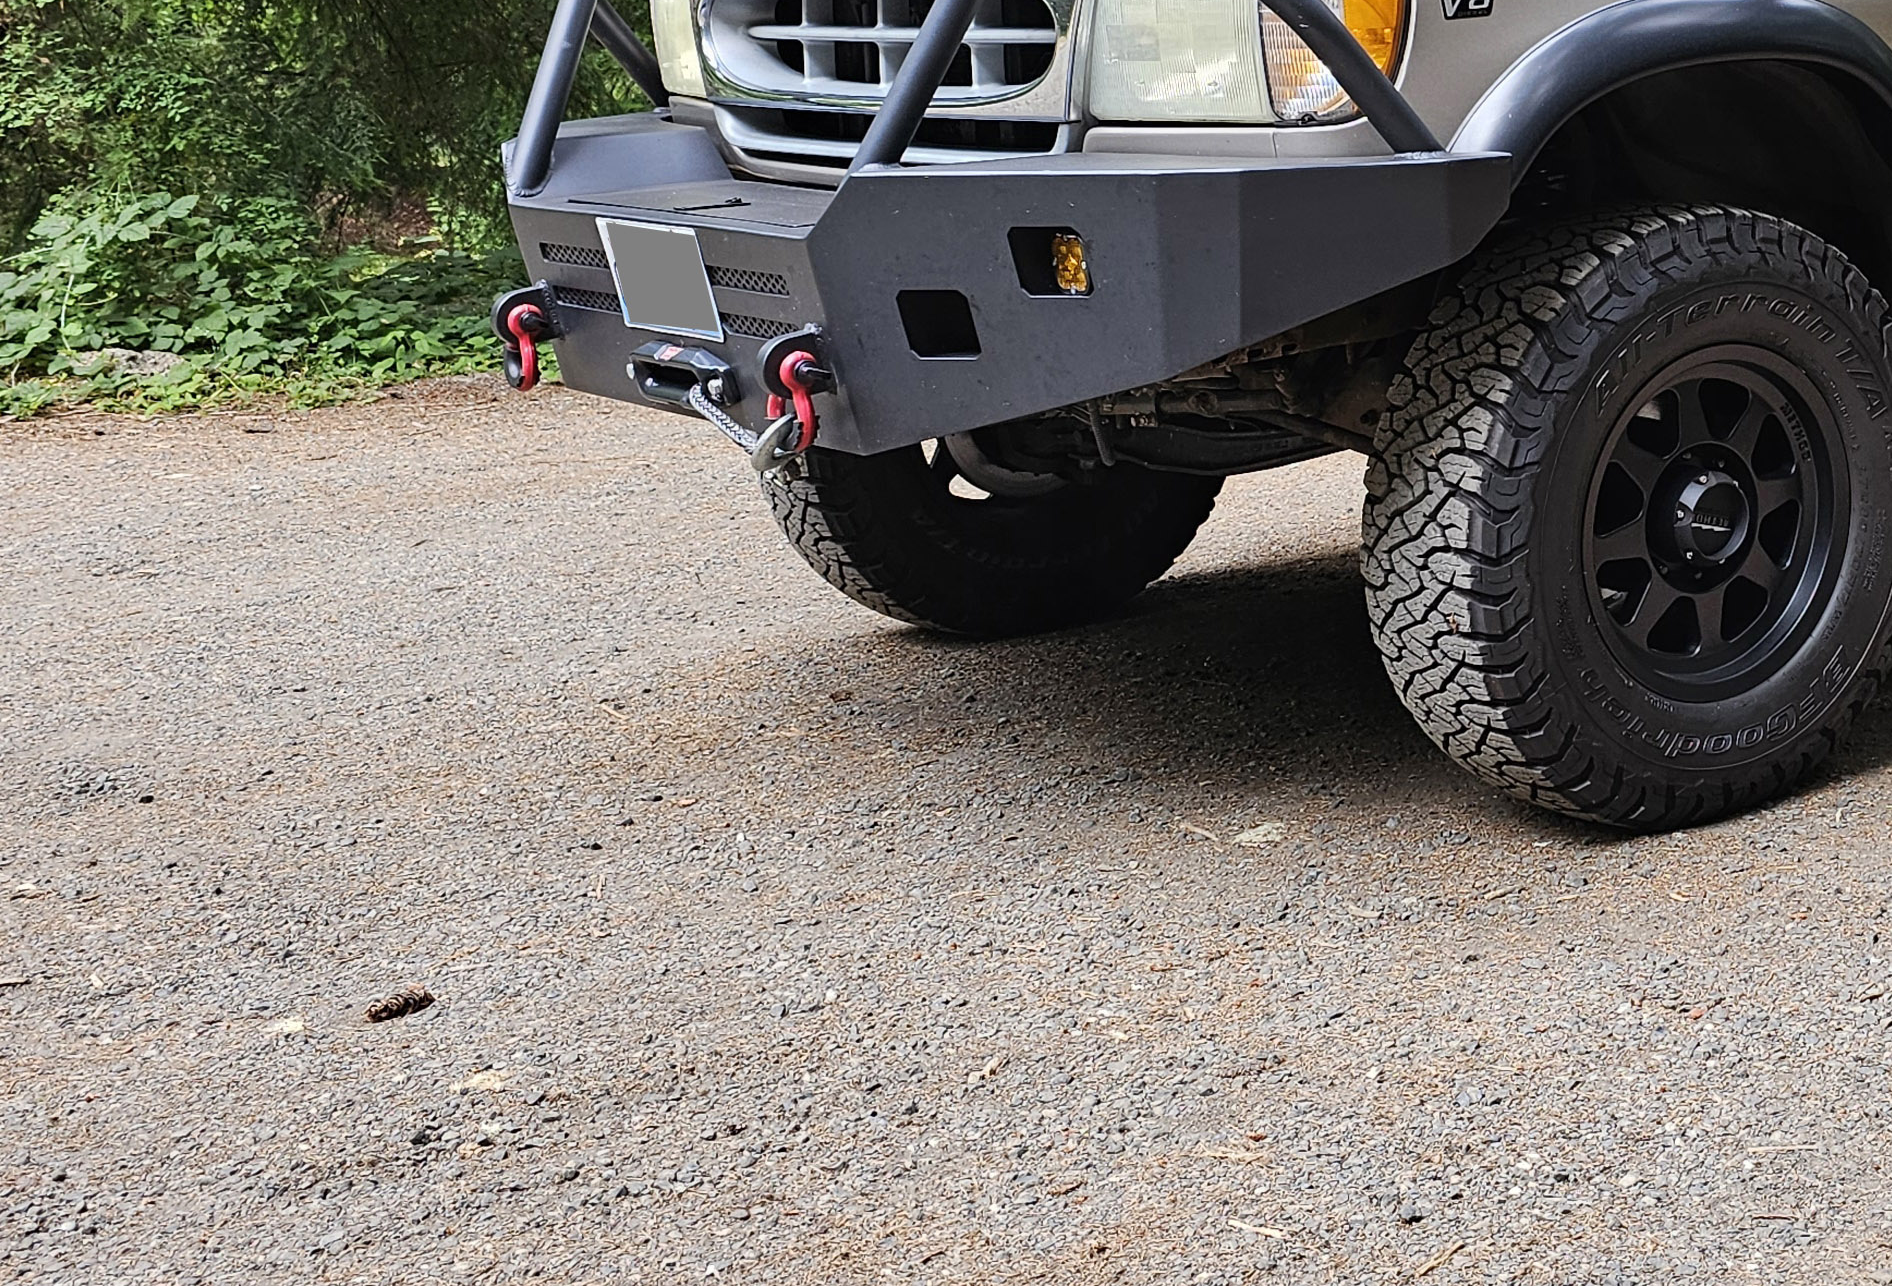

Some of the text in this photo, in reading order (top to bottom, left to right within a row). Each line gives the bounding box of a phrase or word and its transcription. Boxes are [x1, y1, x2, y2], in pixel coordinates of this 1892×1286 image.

[1596, 292, 1837, 417] All-Terrain
[1835, 339, 1889, 420] T/A
[1779, 402, 1812, 462] METHOD
[1578, 645, 1850, 757] BFGoodrich
